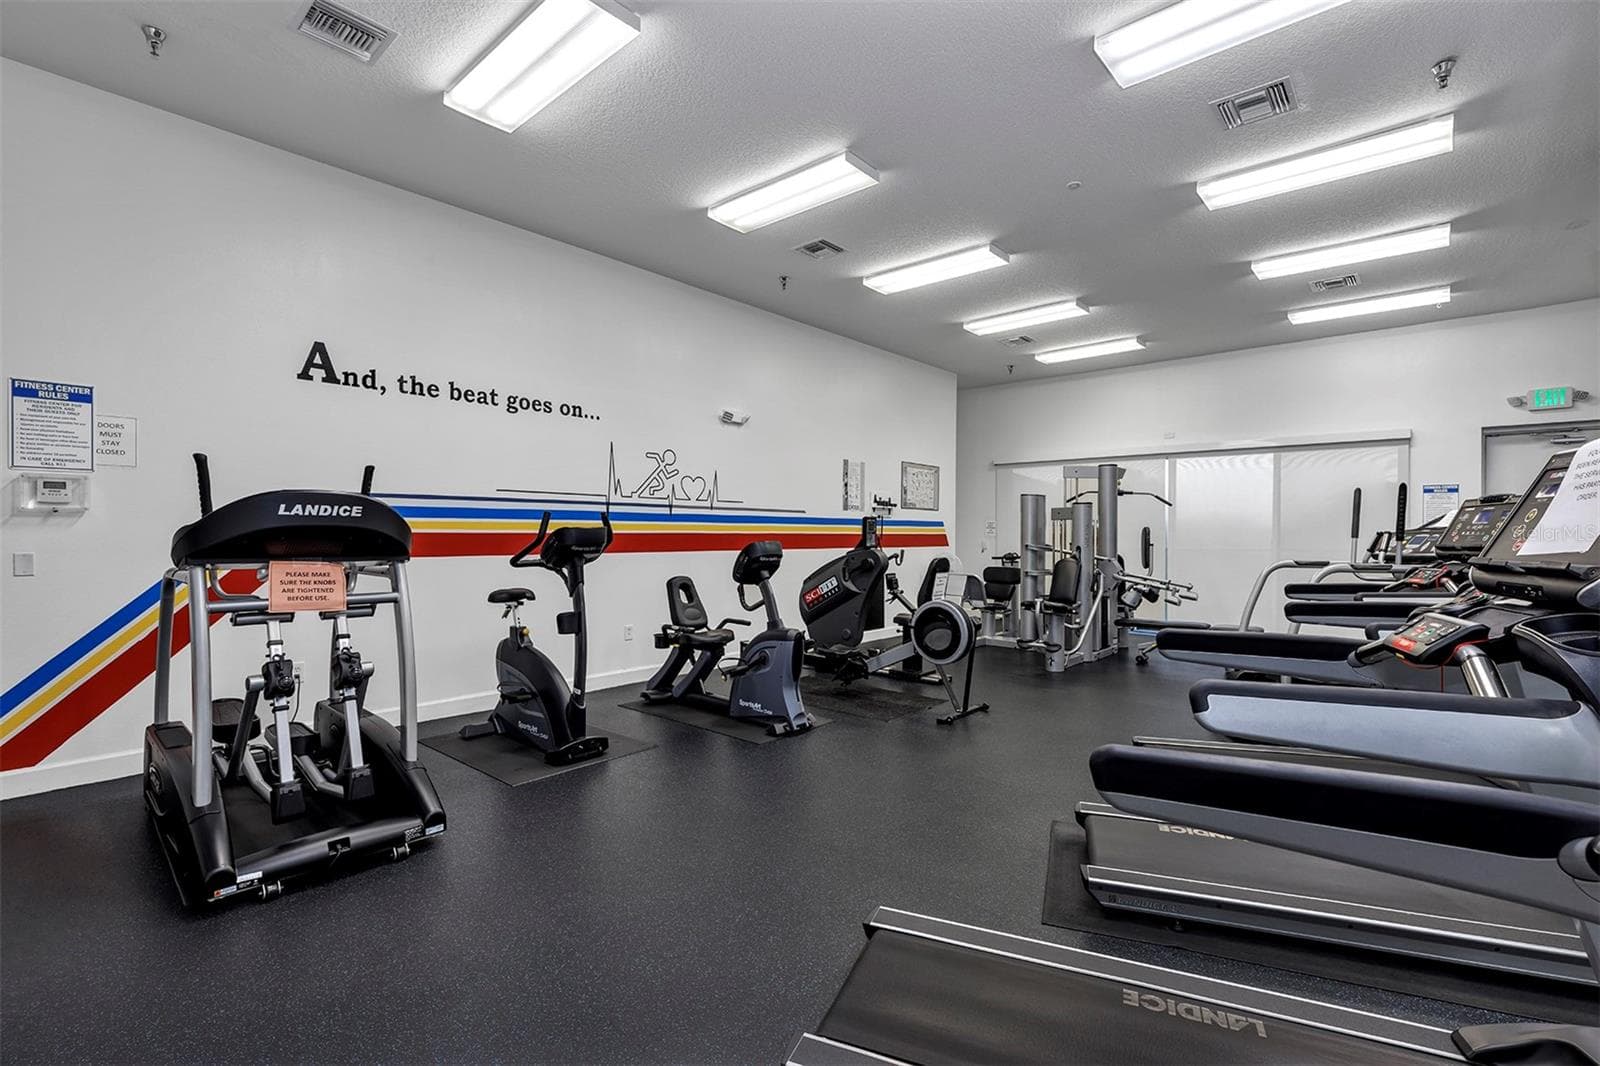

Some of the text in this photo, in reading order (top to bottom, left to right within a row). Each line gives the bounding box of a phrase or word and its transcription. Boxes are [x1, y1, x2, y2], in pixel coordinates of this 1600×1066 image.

[14, 380, 91, 395] FITNESS CENTER
[296, 341, 601, 420] And, the beat goes on...
[38, 390, 69, 400] RULES
[1535, 387, 1566, 408] EXIT
[97, 421, 125, 429] DOORS
[96, 448, 126, 456] CLOSED
[278, 503, 363, 518] LANDICE
[1122, 988, 1269, 1039] LANDICE
